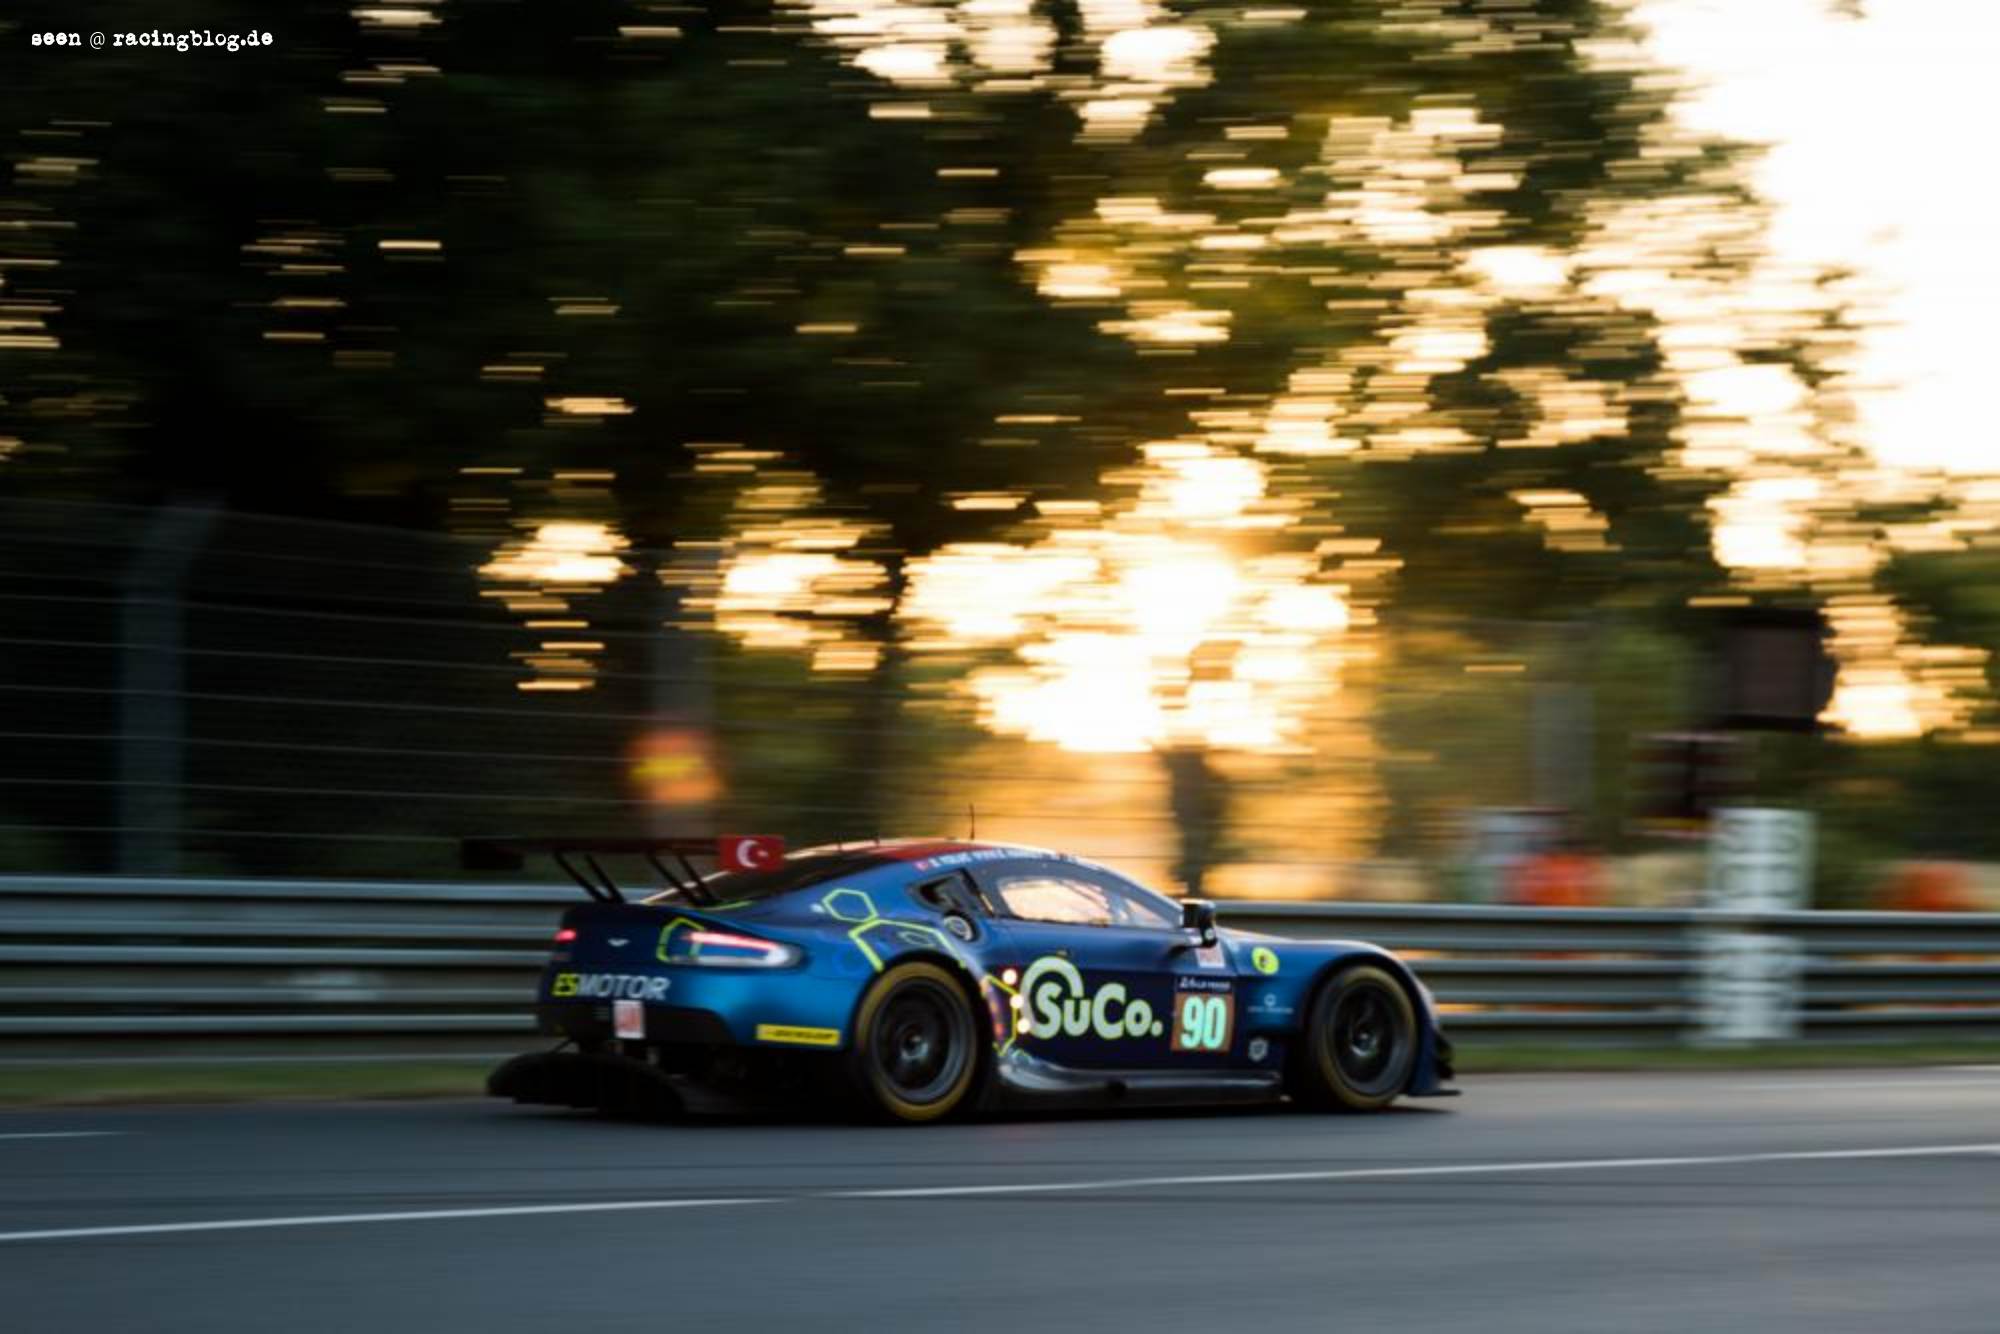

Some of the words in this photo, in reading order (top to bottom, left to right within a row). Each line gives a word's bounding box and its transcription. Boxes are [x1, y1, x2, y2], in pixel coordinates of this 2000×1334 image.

[551, 973, 671, 999] ESMOTOR
[1020, 956, 1164, 1040] SuCo.
[1181, 995, 1226, 1048] 90
